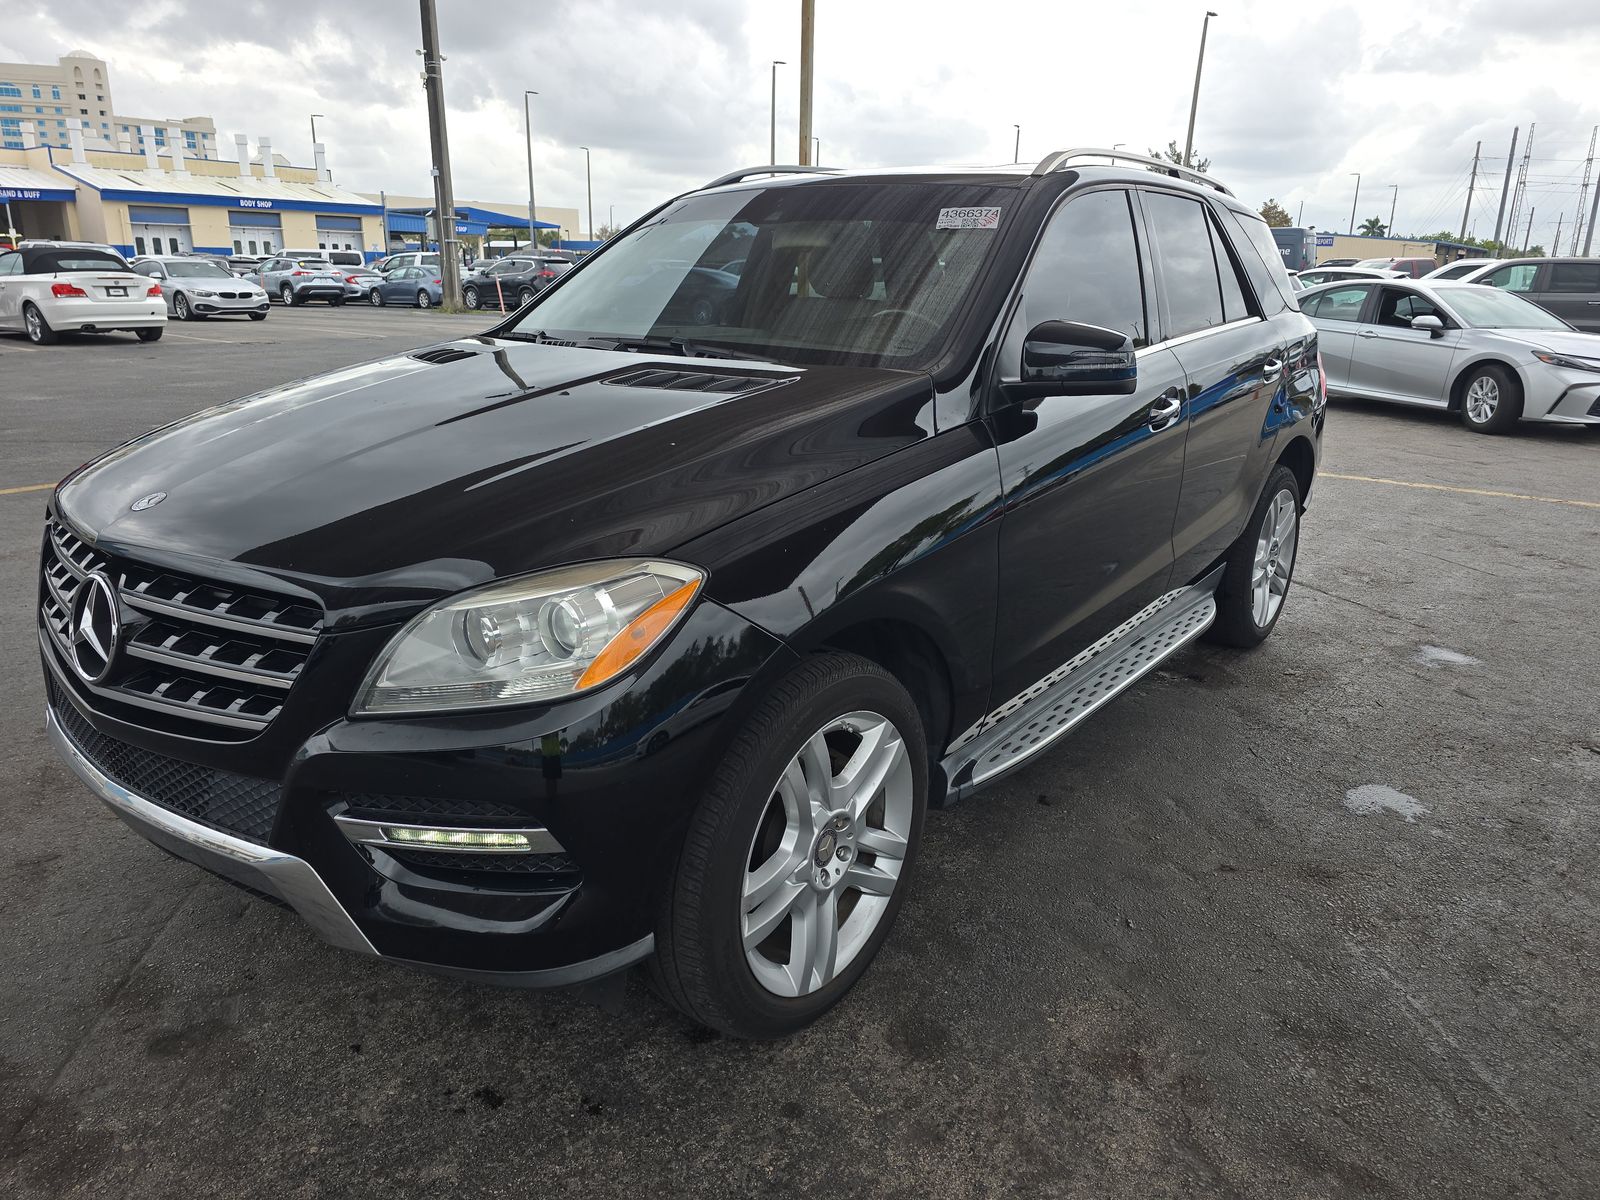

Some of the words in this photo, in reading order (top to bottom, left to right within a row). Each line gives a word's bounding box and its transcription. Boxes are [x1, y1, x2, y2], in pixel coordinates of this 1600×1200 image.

[17, 190, 23, 198] &
[24, 190, 40, 198] BUFF
[240, 199, 256, 207] BODY
[942, 209, 999, 219] 4366374
